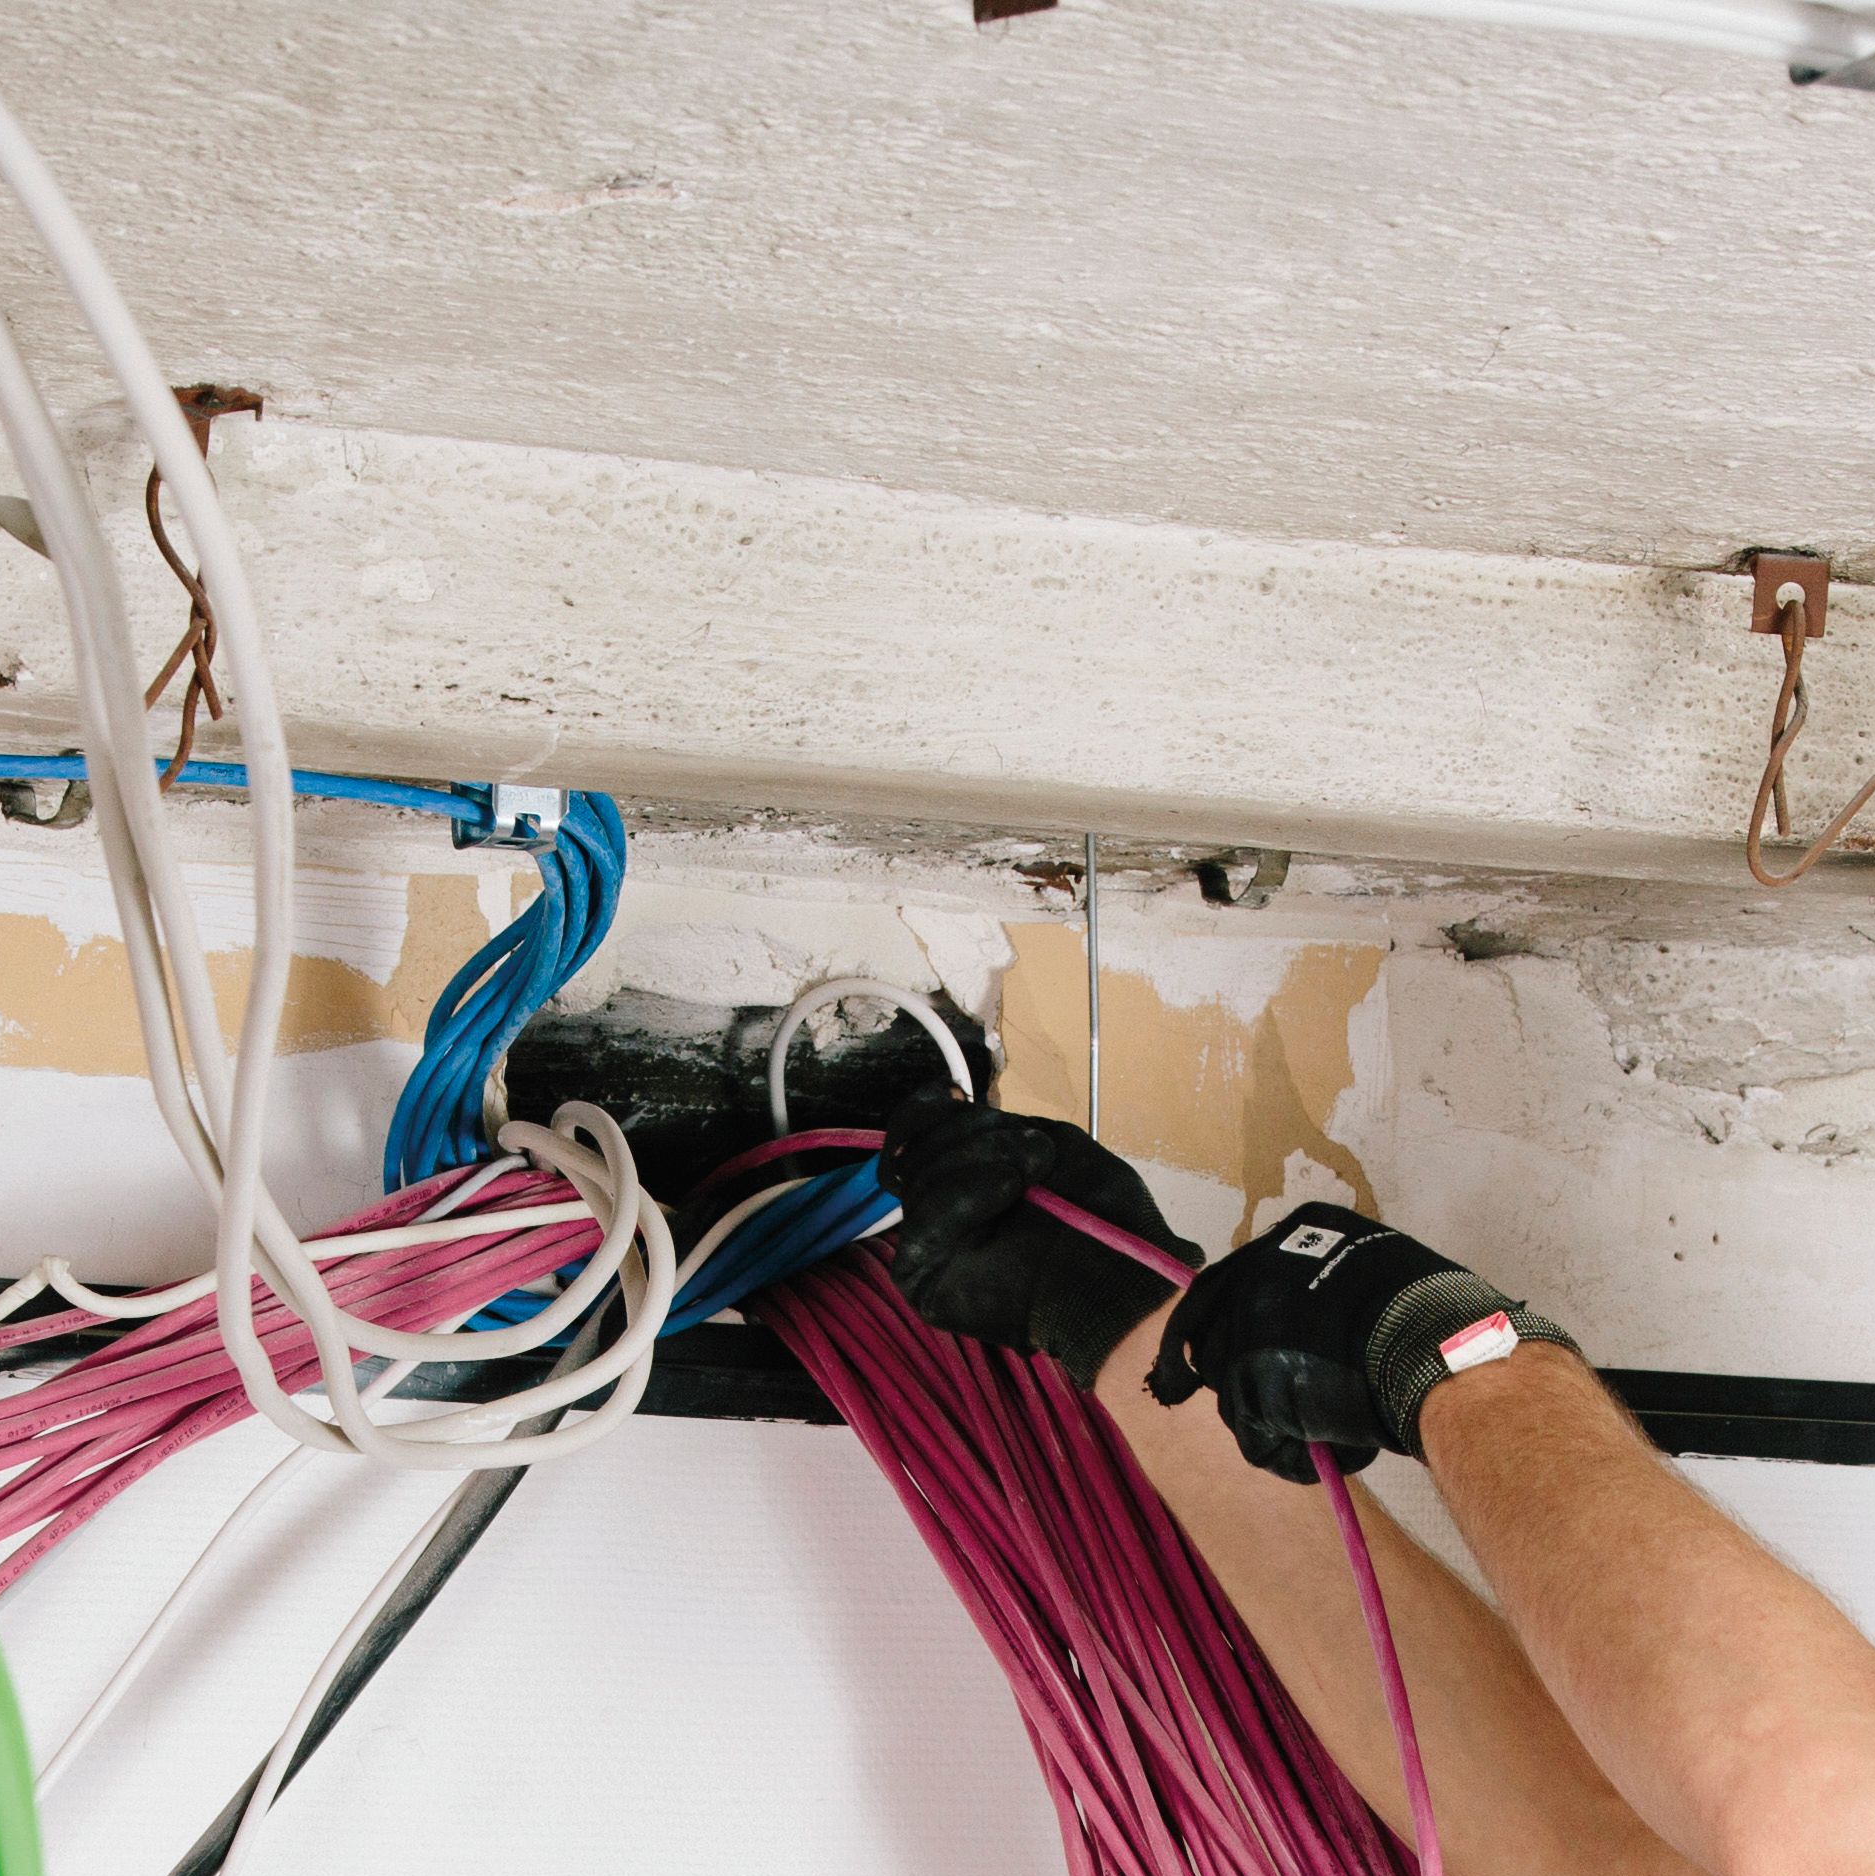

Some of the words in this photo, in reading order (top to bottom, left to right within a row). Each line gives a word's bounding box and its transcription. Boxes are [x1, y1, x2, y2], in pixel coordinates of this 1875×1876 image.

[12, 1542, 44, 1576] Q-LINE
[75, 1507, 89, 1521] SC
[157, 1423, 202, 1459] VERIFIED
